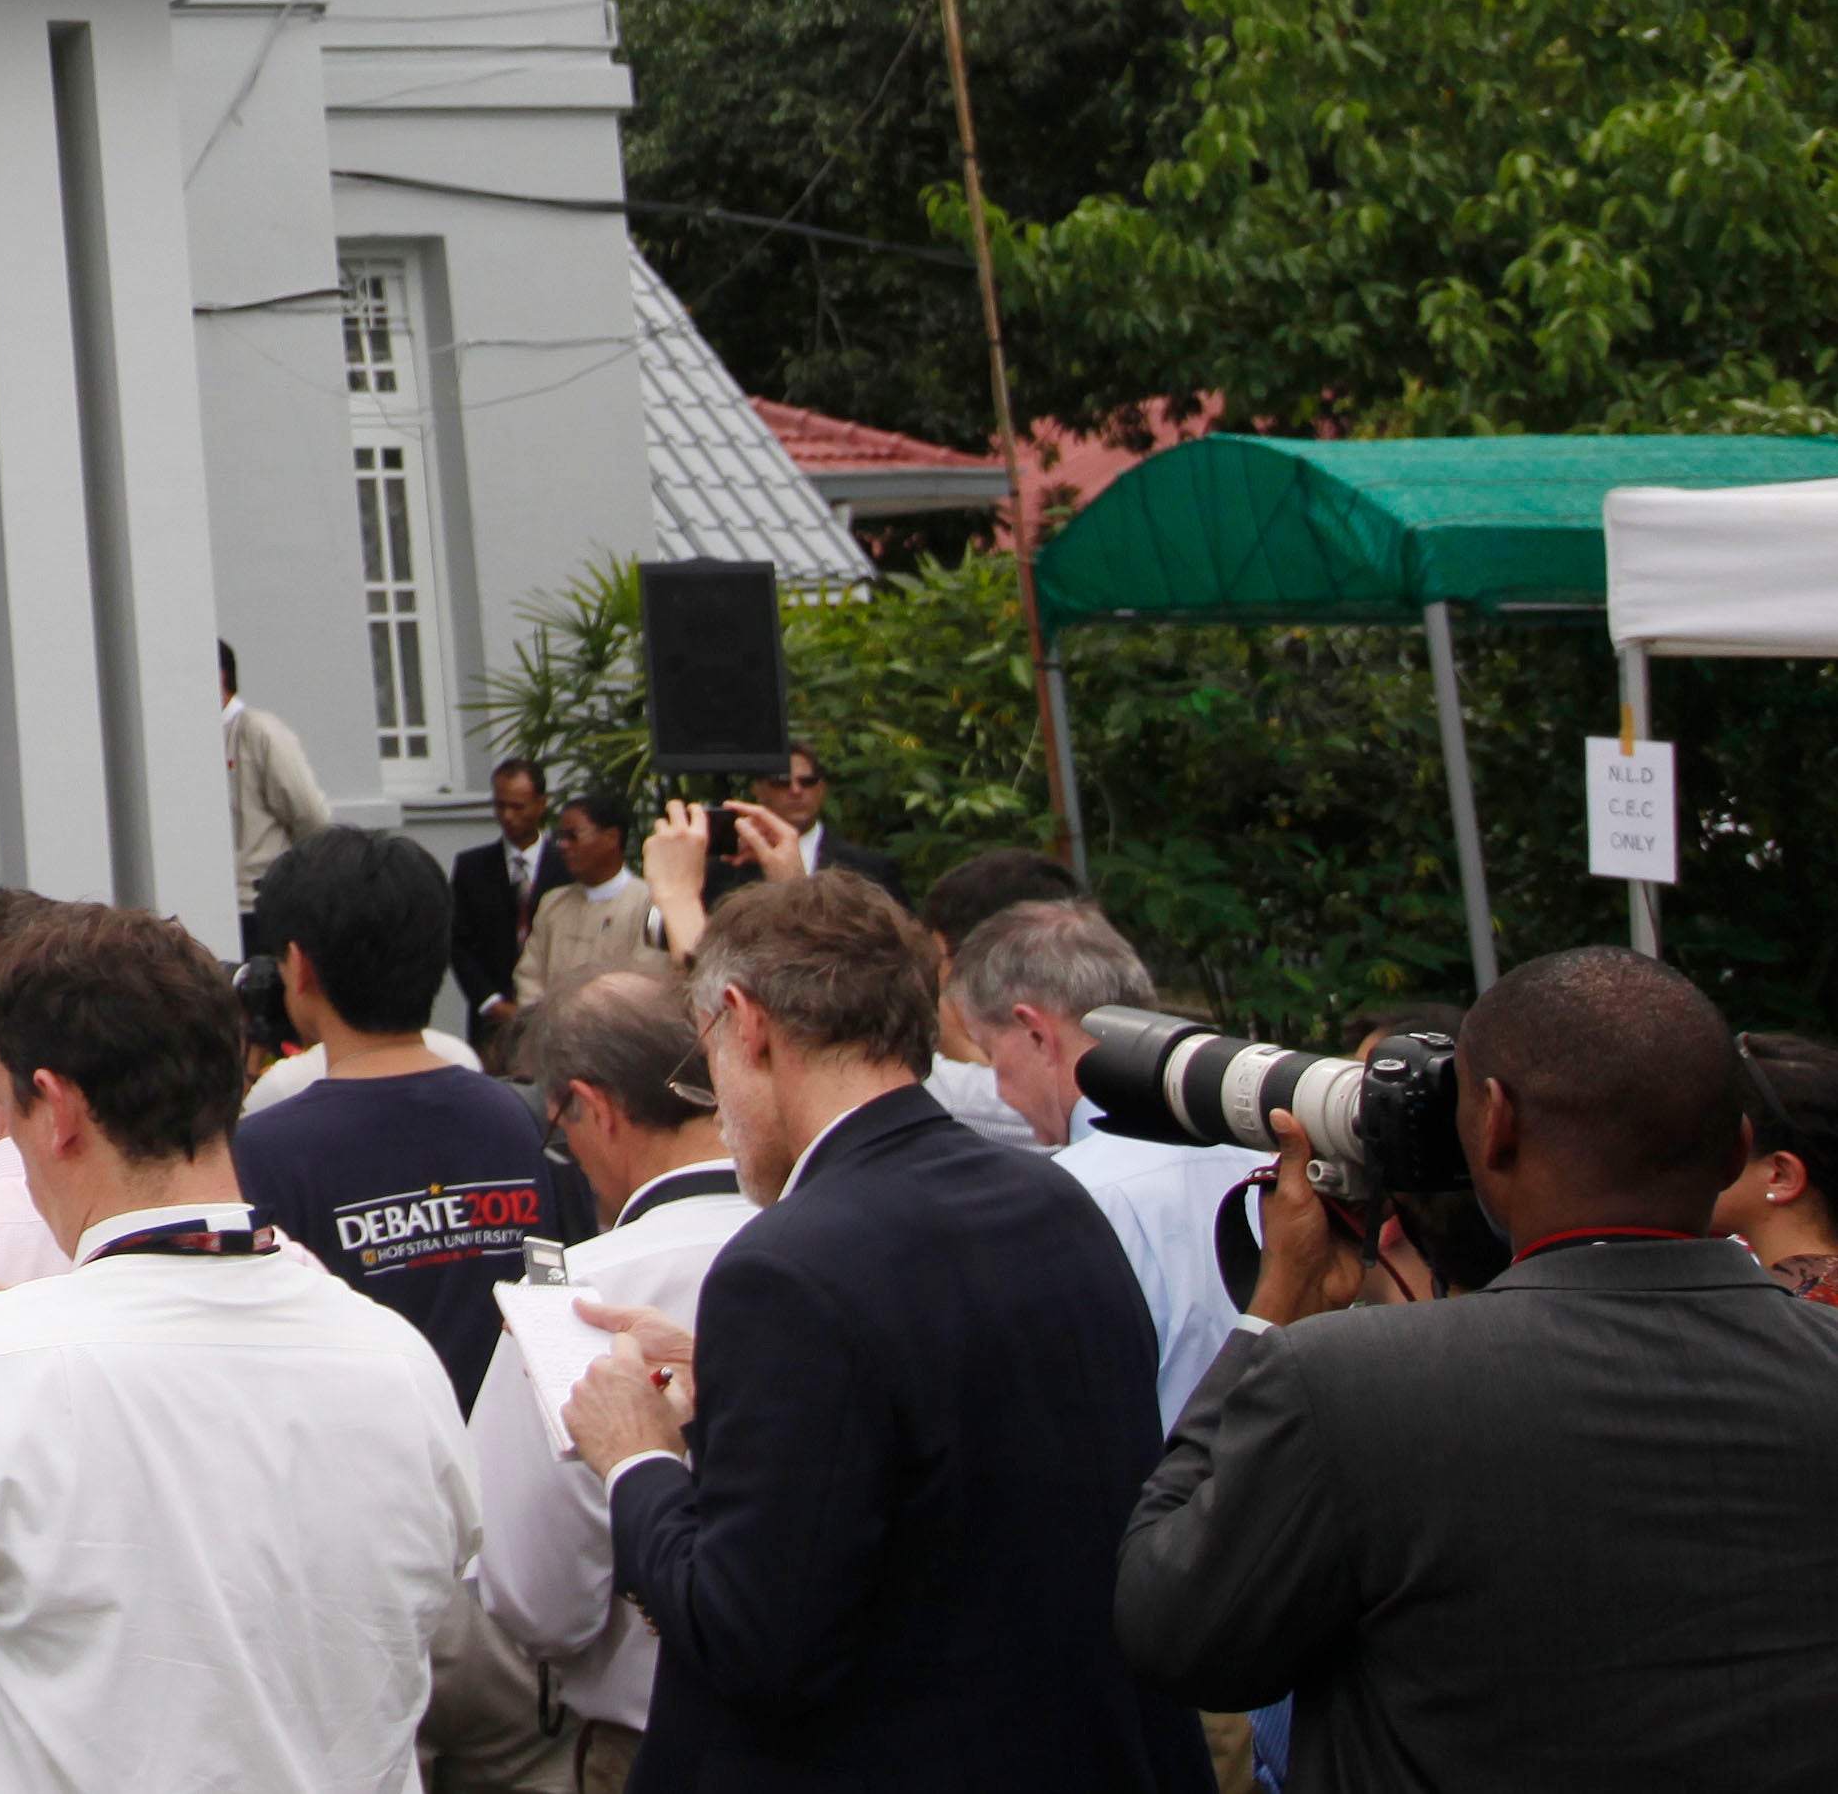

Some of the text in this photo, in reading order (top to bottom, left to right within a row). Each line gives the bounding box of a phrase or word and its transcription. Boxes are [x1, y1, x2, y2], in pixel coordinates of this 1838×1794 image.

[1608, 766, 1654, 783] N.L.D
[1608, 798, 1653, 819] C.E.C
[1610, 831, 1655, 851] ONLY
[377, 1237, 443, 1261] HOFSTRA
